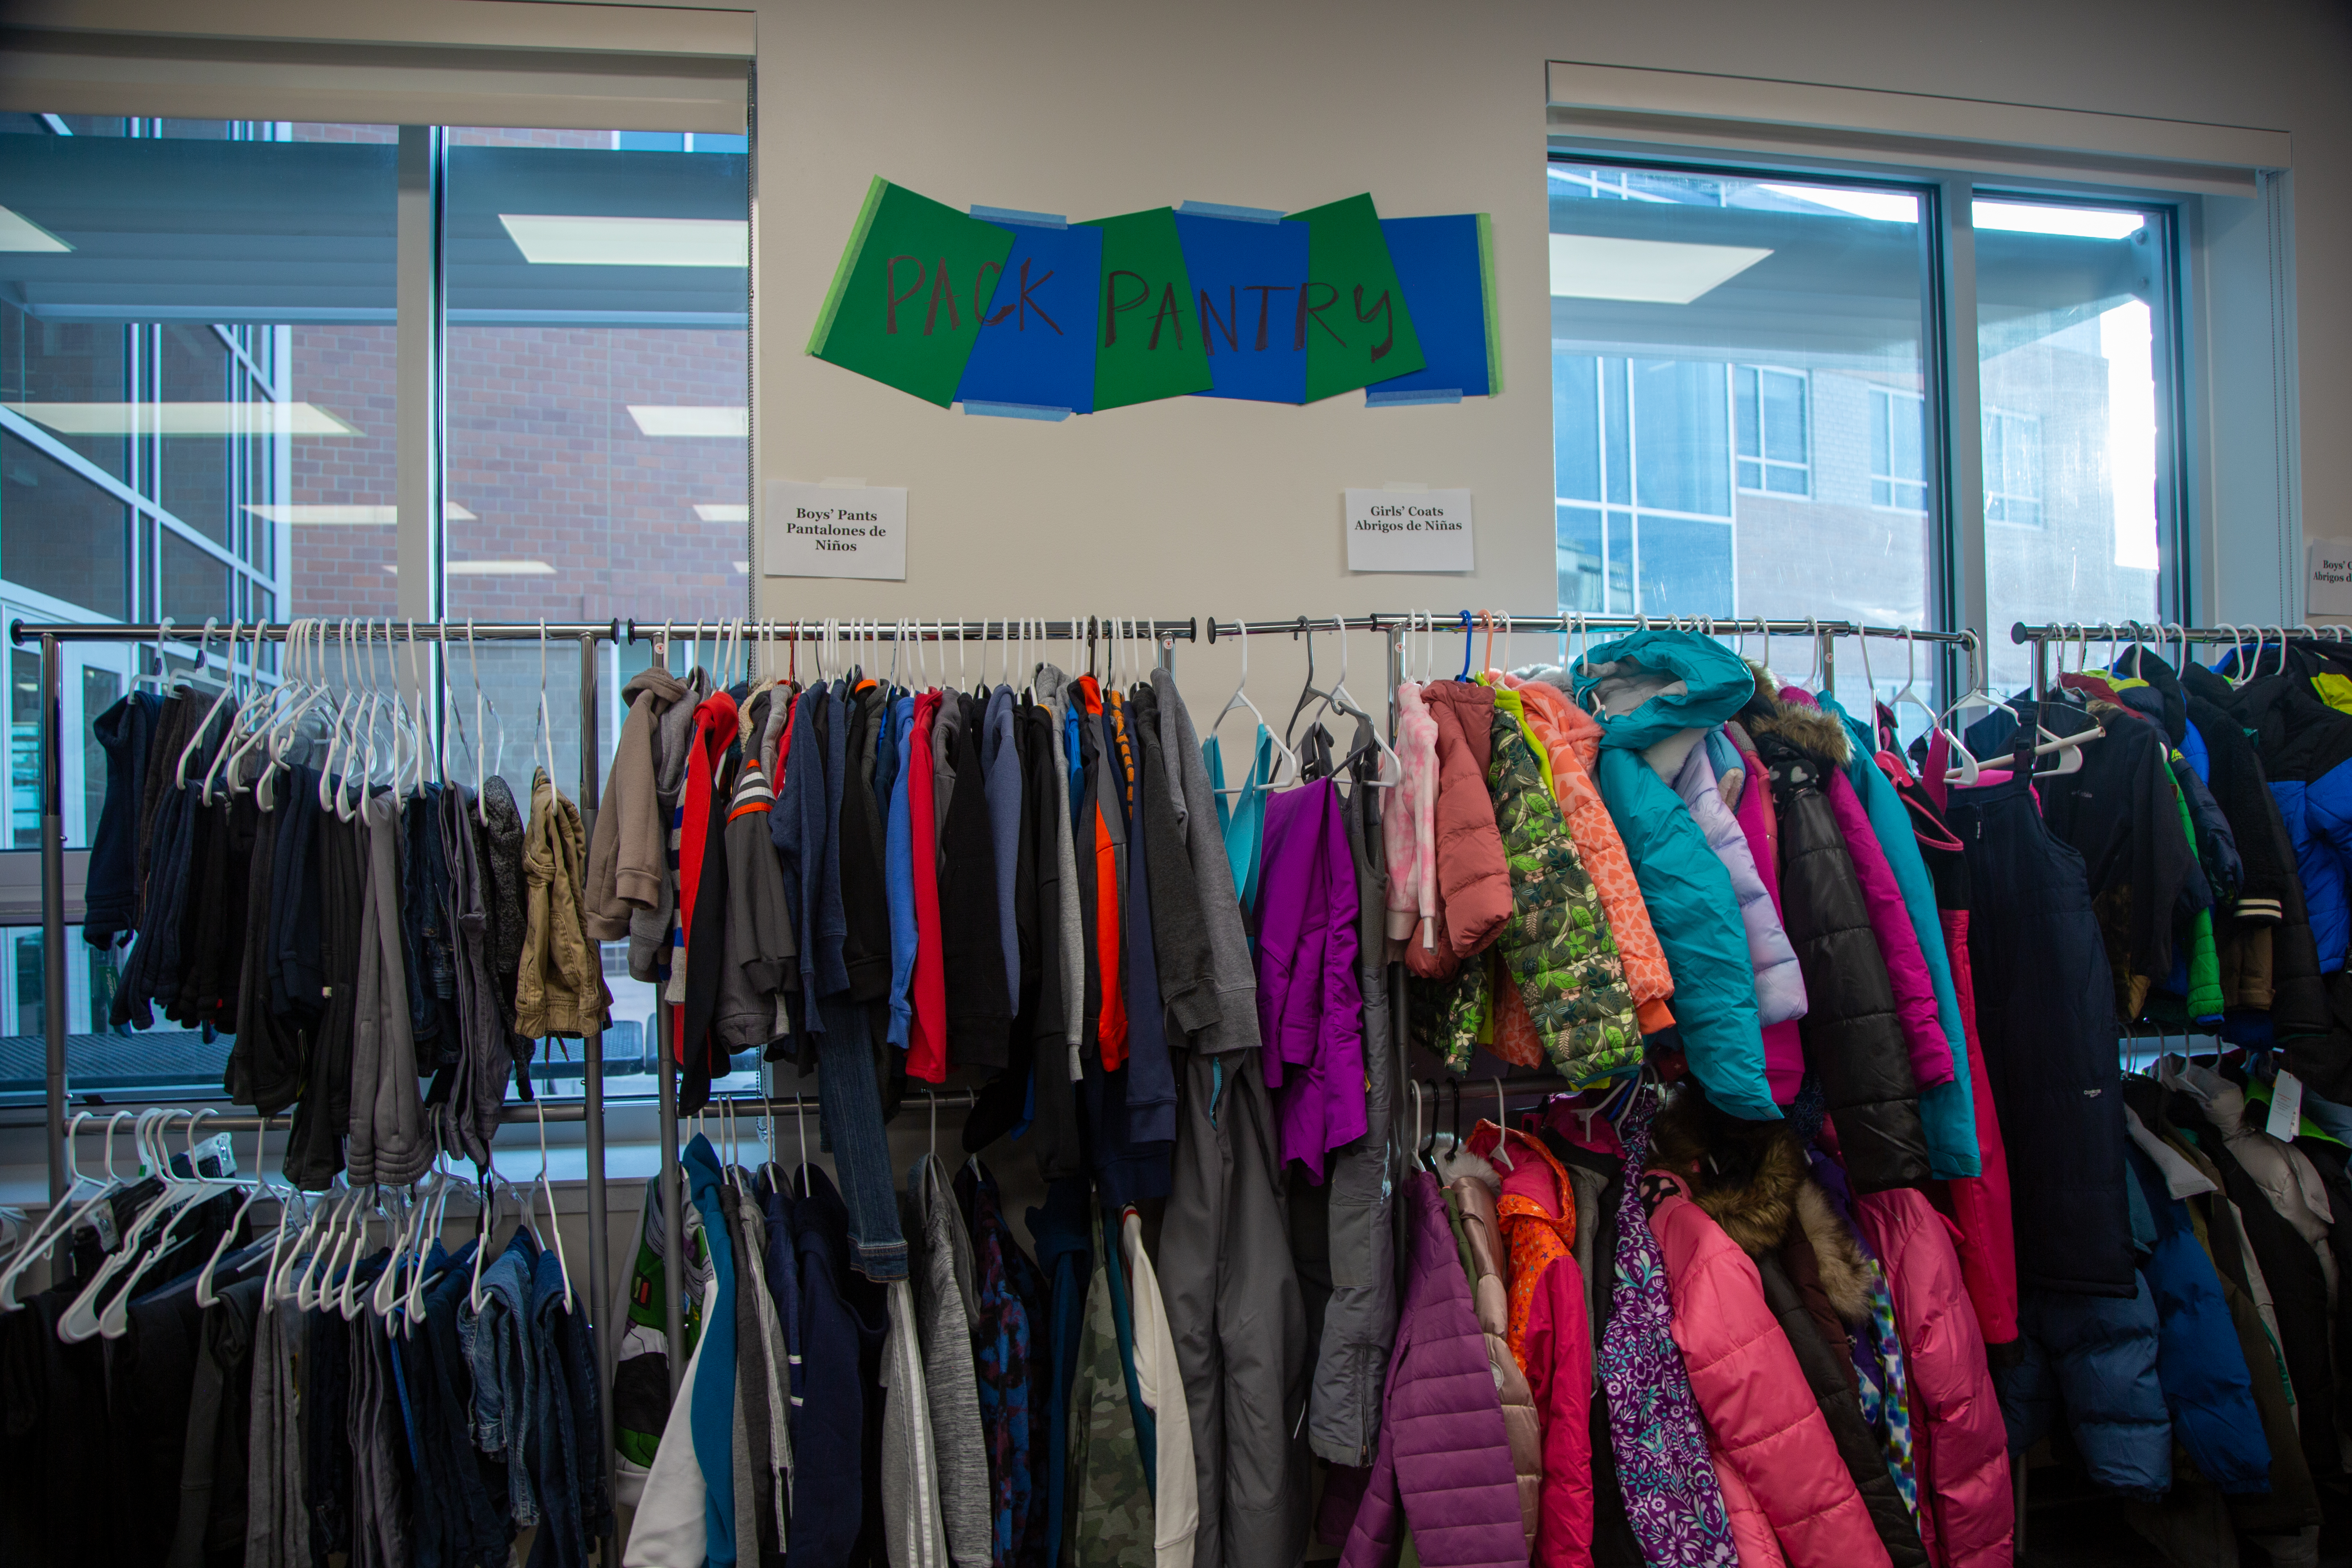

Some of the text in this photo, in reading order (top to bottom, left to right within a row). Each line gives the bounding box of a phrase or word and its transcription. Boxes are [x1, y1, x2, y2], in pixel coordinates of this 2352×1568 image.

[887, 255, 1394, 363] PACK PANTRY
[796, 507, 877, 522] Boys’ Pants
[1370, 506, 1444, 516] Girls’ Coats
[786, 523, 886, 536] Pantalones de
[1354, 520, 1462, 533] Abrigos de Niñas
[815, 539, 857, 551] Niños
[2322, 560, 2346, 571] Boys’
[2313, 571, 2344, 584] Abrigos
